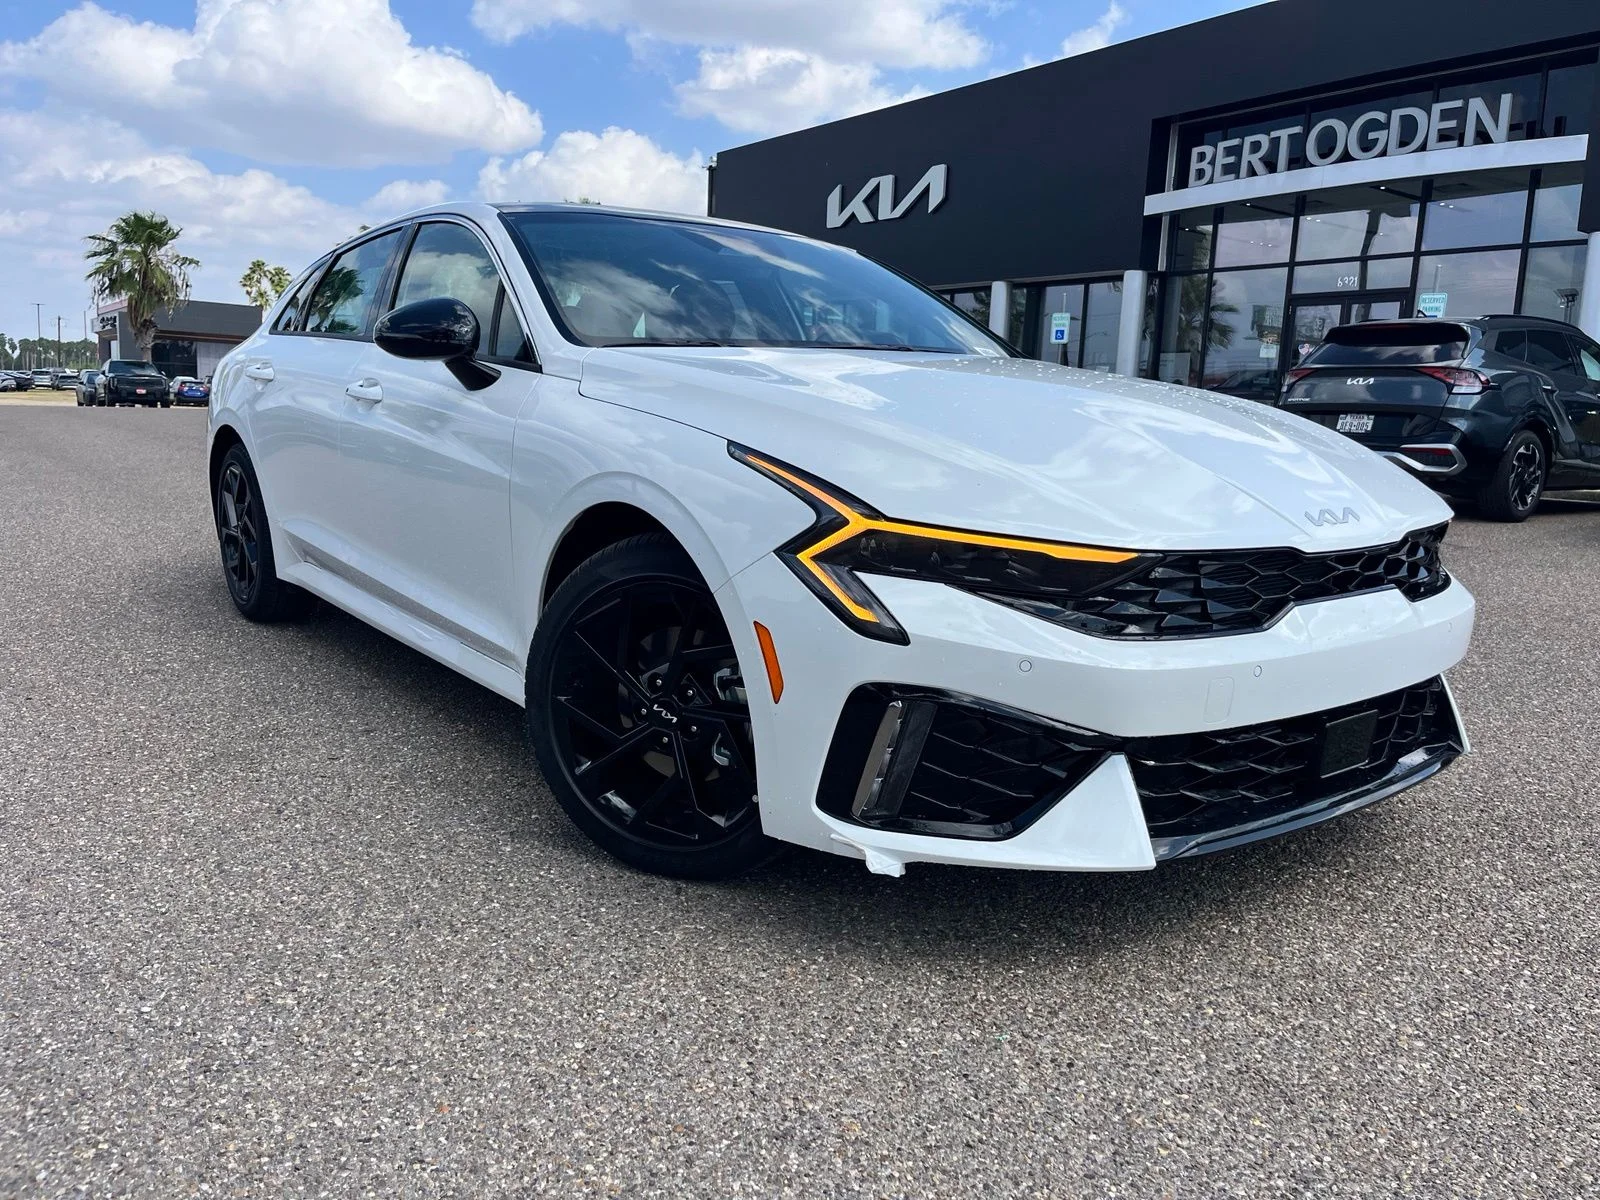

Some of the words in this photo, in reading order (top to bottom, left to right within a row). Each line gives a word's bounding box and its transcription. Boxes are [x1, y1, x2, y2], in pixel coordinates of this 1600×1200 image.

[1188, 125, 1303, 188] BERT
[1306, 93, 1513, 166] OGDEN
[826, 163, 947, 229] KIA
[1337, 276, 1358, 287] 6321
[1304, 507, 1360, 526] KIA
[653, 704, 677, 723] KIA
